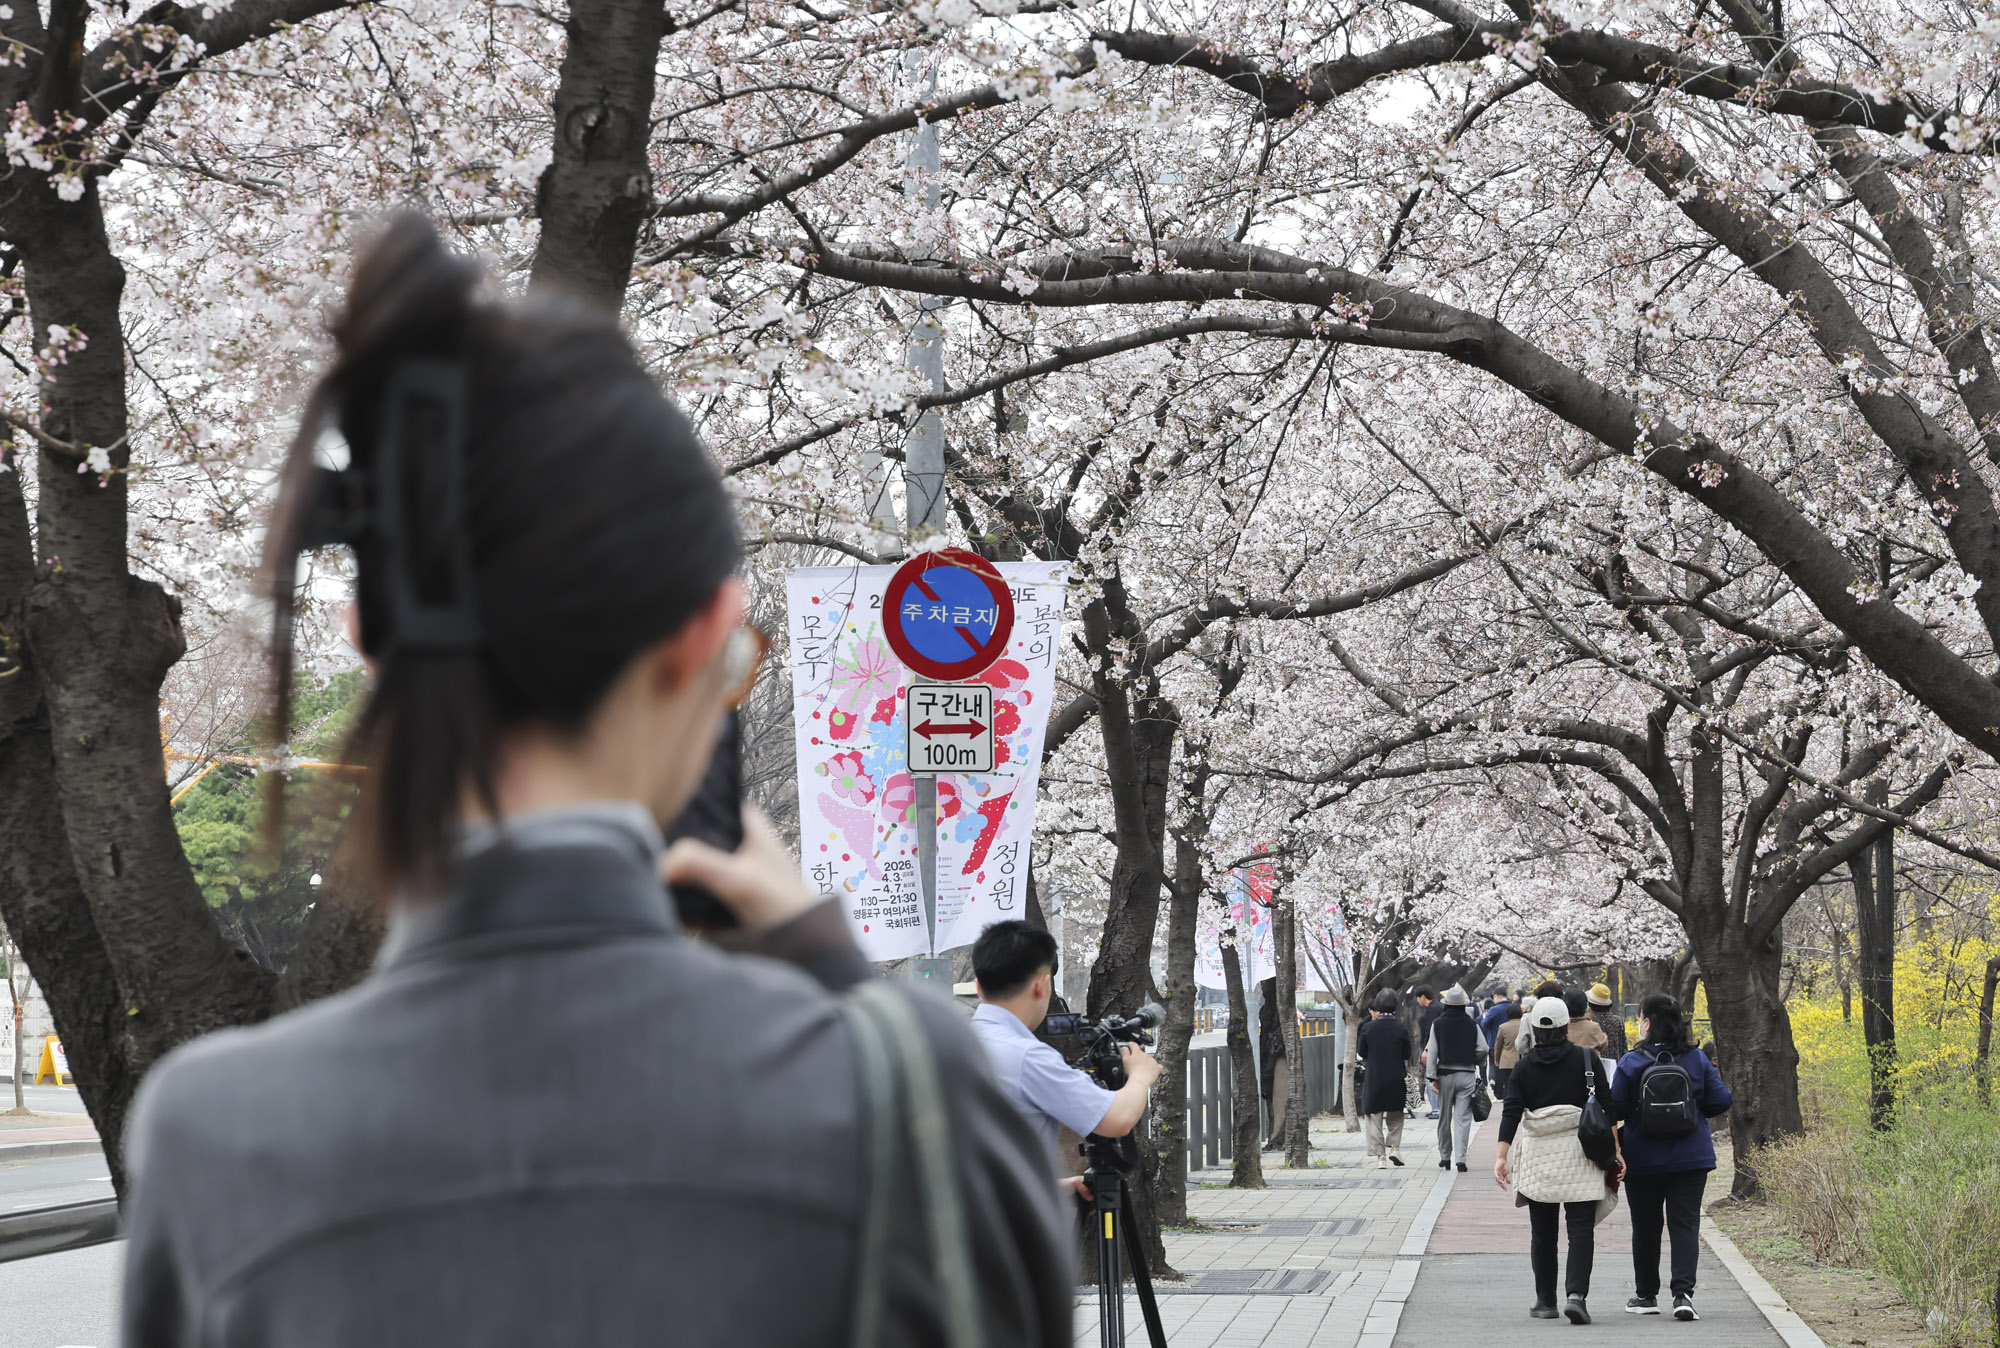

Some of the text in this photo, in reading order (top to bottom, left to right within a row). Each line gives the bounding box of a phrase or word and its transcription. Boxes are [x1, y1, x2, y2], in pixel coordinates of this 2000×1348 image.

[1010, 587, 1037, 604] 의도
[902, 603, 994, 626] 주차금지
[1025, 604, 1057, 669] 봄의
[796, 615, 828, 681] 모두
[917, 692, 982, 717] 구간내
[924, 744, 976, 765] 100m
[884, 860, 914, 872] 2026.
[989, 841, 1019, 911] 정원
[853, 904, 919, 920] 영등포구 여의서로
[885, 916, 921, 929] 국회뒤편
